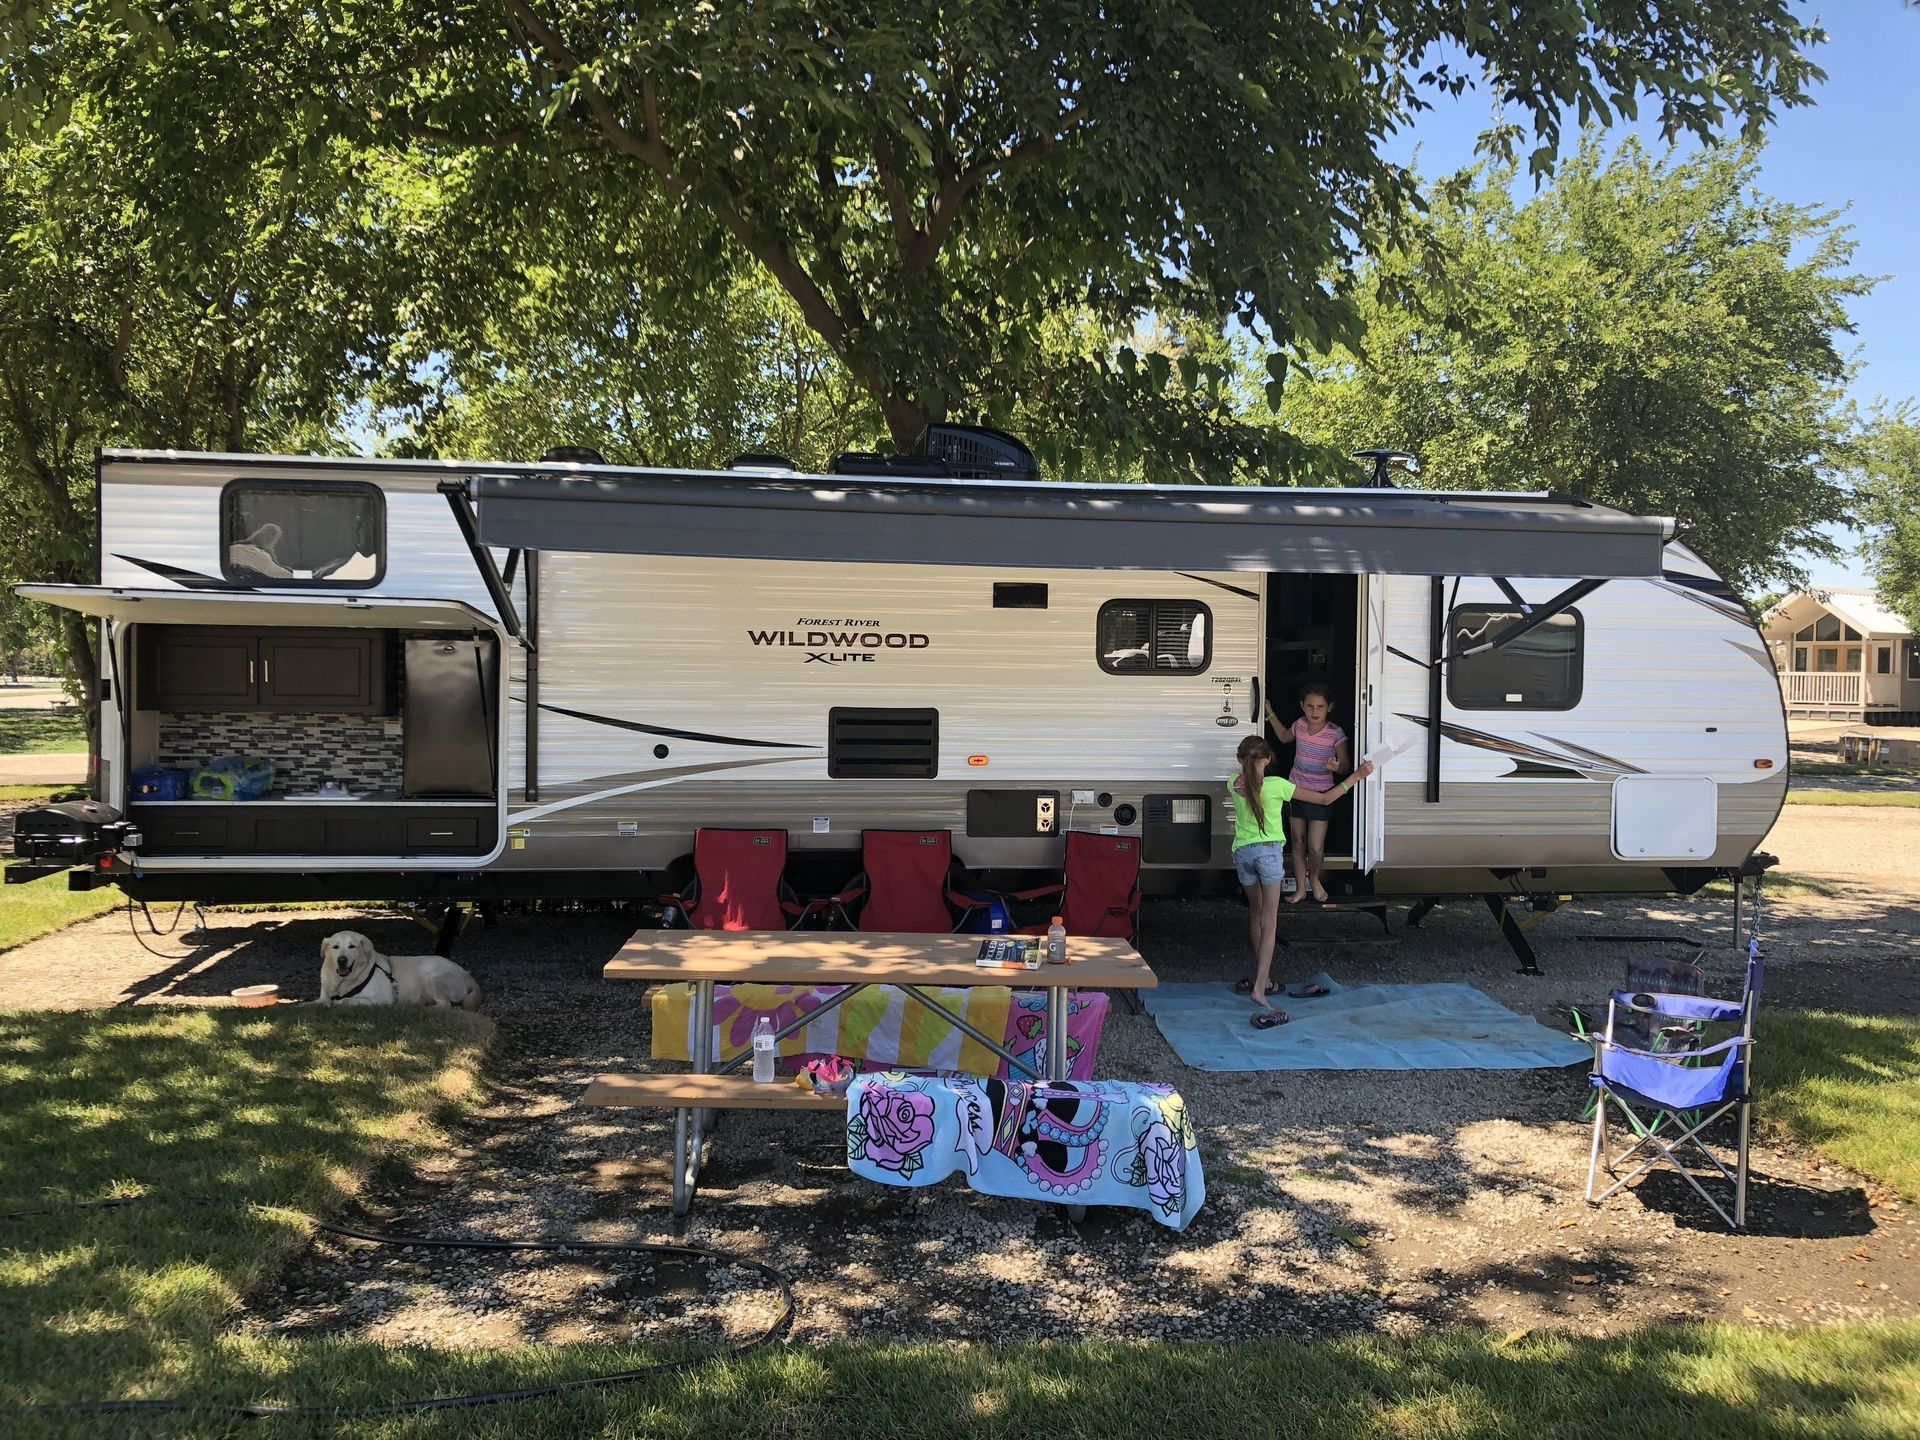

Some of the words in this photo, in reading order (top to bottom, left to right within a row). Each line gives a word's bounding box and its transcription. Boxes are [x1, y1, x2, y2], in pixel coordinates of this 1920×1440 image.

[796, 617, 842, 626] FOREST
[844, 618, 880, 627] RIVER
[747, 630, 930, 648] WILDWOOD
[1049, 942, 1056, 951] G
